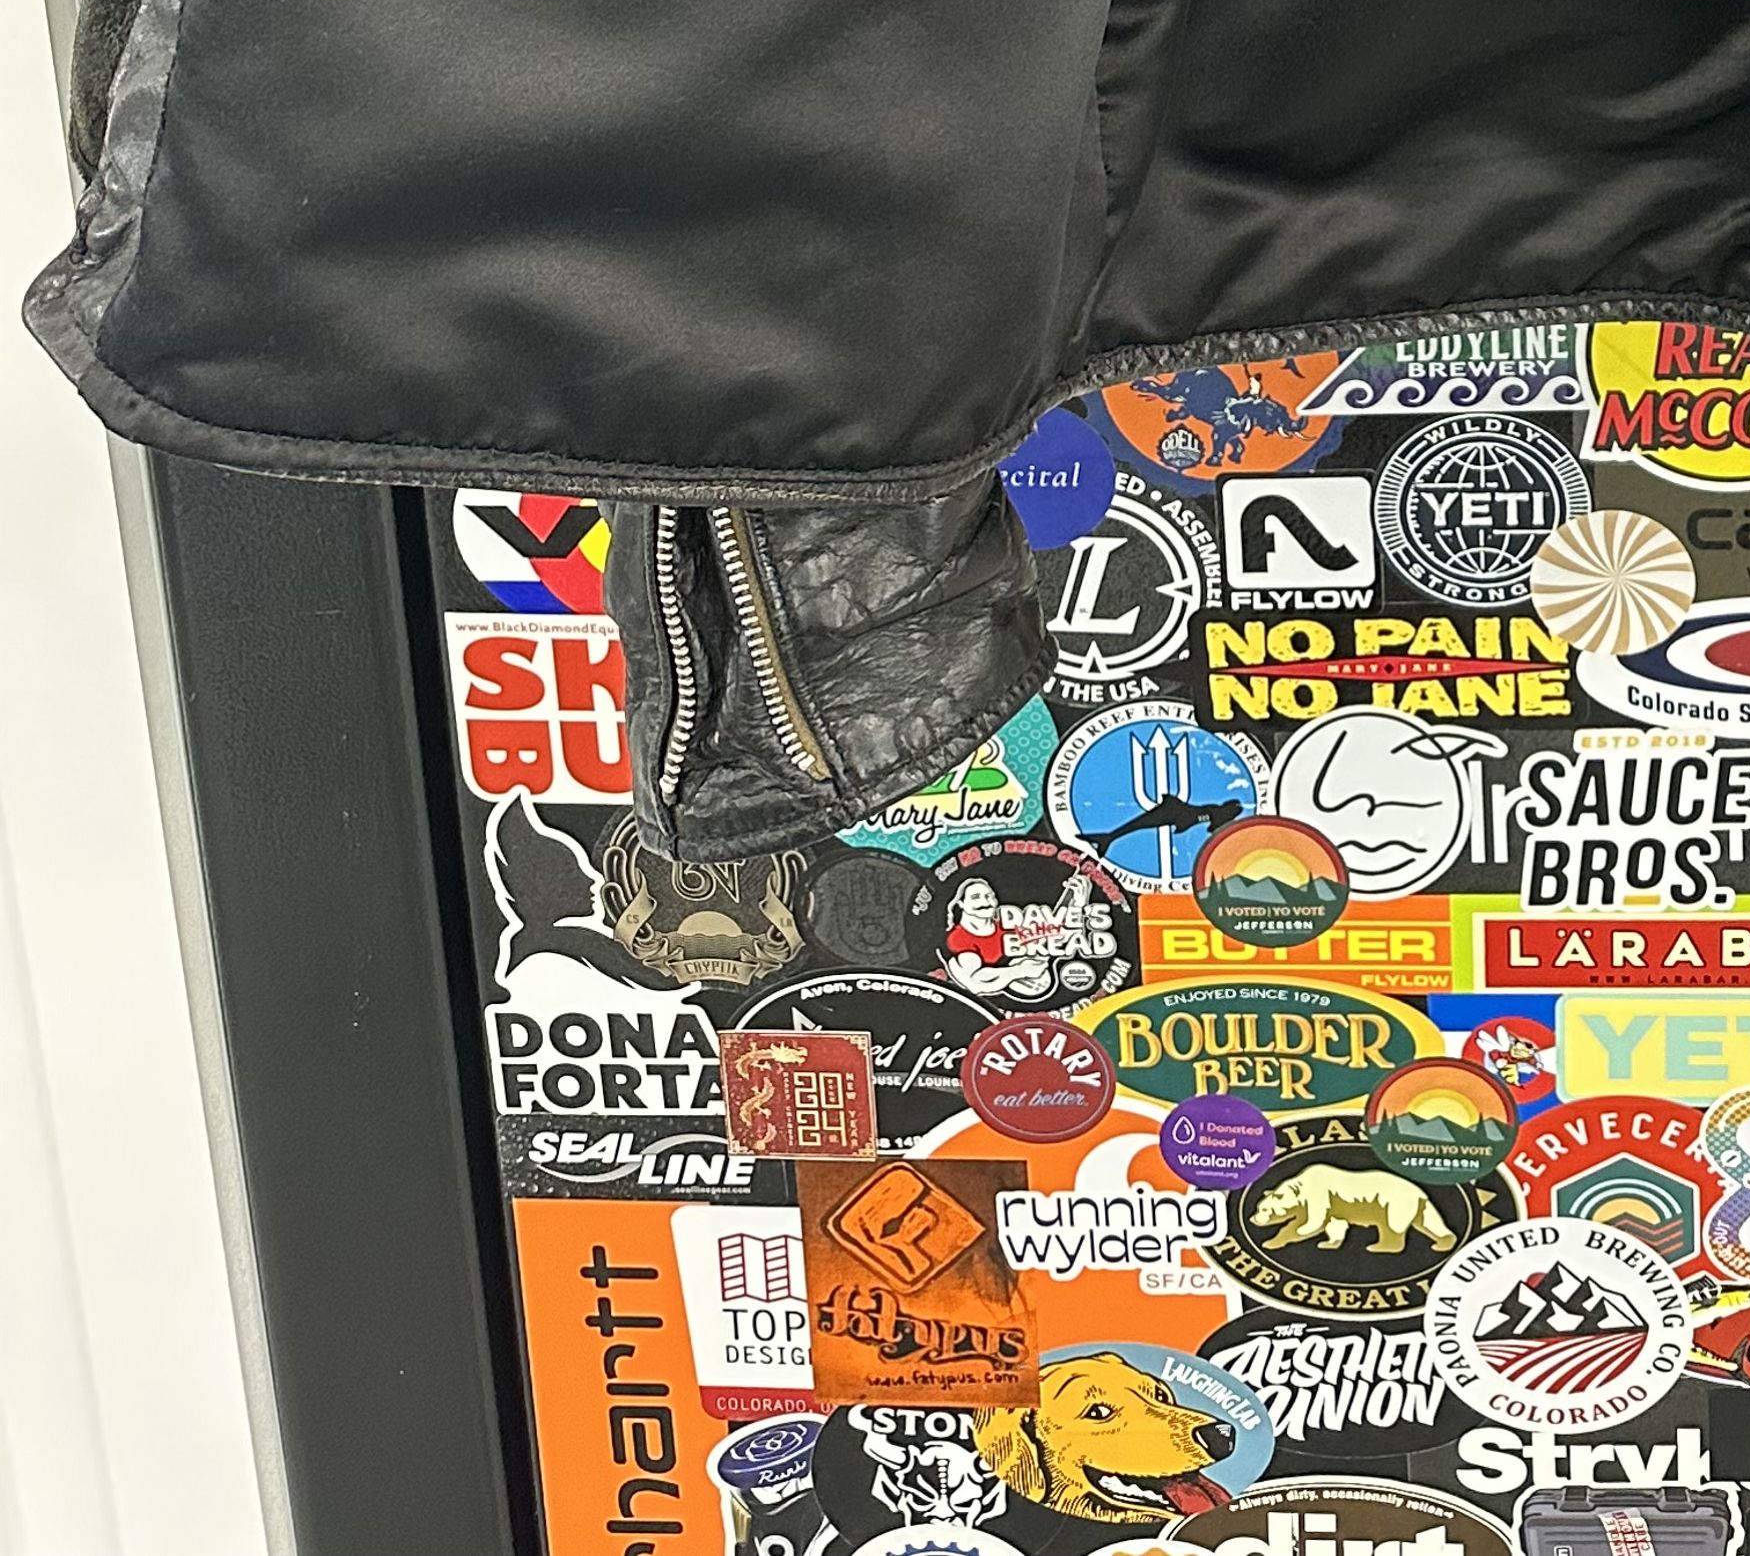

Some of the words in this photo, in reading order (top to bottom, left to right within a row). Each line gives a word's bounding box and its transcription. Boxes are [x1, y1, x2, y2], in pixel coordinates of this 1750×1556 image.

[1408, 359, 1555, 378] BREWERY
[1424, 418, 1544, 442] WILDLY
[1421, 492, 1547, 527] YETI
[1408, 562, 1529, 603] STRONG
[1231, 590, 1373, 610] FLYLOW
[1205, 620, 1335, 668] NO
[1354, 618, 1571, 666] PAIN
[1327, 664, 1379, 675] MARY
[1399, 663, 1453, 673] JANE
[1061, 682, 1104, 702] THE
[1110, 676, 1160, 702] USA
[1211, 675, 1337, 720] NO
[1370, 670, 1572, 718] JANE
[1627, 685, 1730, 723] Colorado
[1581, 737, 1645, 749] ESTD
[1651, 736, 1707, 747] 2018
[1054, 734, 1090, 812] BAMBOO
[1089, 705, 1137, 740] REEF
[1528, 837, 1730, 906] BROS.
[1001, 903, 1112, 931] DAVE'S
[1226, 906, 1268, 917] VOTED
[1272, 906, 1290, 917] YO
[1234, 921, 1314, 930] JEFFERSON
[1003, 930, 1117, 957] BREAD
[856, 979, 945, 1004] Colorado
[1362, 975, 1449, 987] FLYLOW
[1164, 989, 1237, 1007] ENJOYED
[1239, 988, 1288, 1001] SINCE
[1293, 992, 1331, 1006] 1979
[1115, 1011, 1396, 1070] BOULDER
[1194, 1056, 1316, 1100] BEER
[1200, 1136, 1236, 1148] Blood
[1207, 1123, 1263, 1136] Donated
[529, 1133, 642, 1164] SEAL
[1178, 1152, 1246, 1170] vitalant
[1394, 1143, 1436, 1154] VOTED
[1441, 1144, 1459, 1155] YO
[639, 1158, 754, 1185] LINE
[1401, 1157, 1480, 1169] JEFFERSON
[1002, 1189, 1218, 1238] running
[1007, 1229, 1187, 1276] wylder
[1217, 1235, 1275, 1286] THE
[1282, 1280, 1410, 1309] GREAT
[1452, 1226, 1558, 1282] UNITED
[1585, 1233, 1688, 1329] BREWING
[1646, 1342, 1682, 1376] CO.
[1434, 1296, 1481, 1387] PAONIA
[1161, 1357, 1234, 1409] LAUGHING
[1227, 1390, 1263, 1430] LAB
[1489, 1384, 1648, 1425] COLORADO
